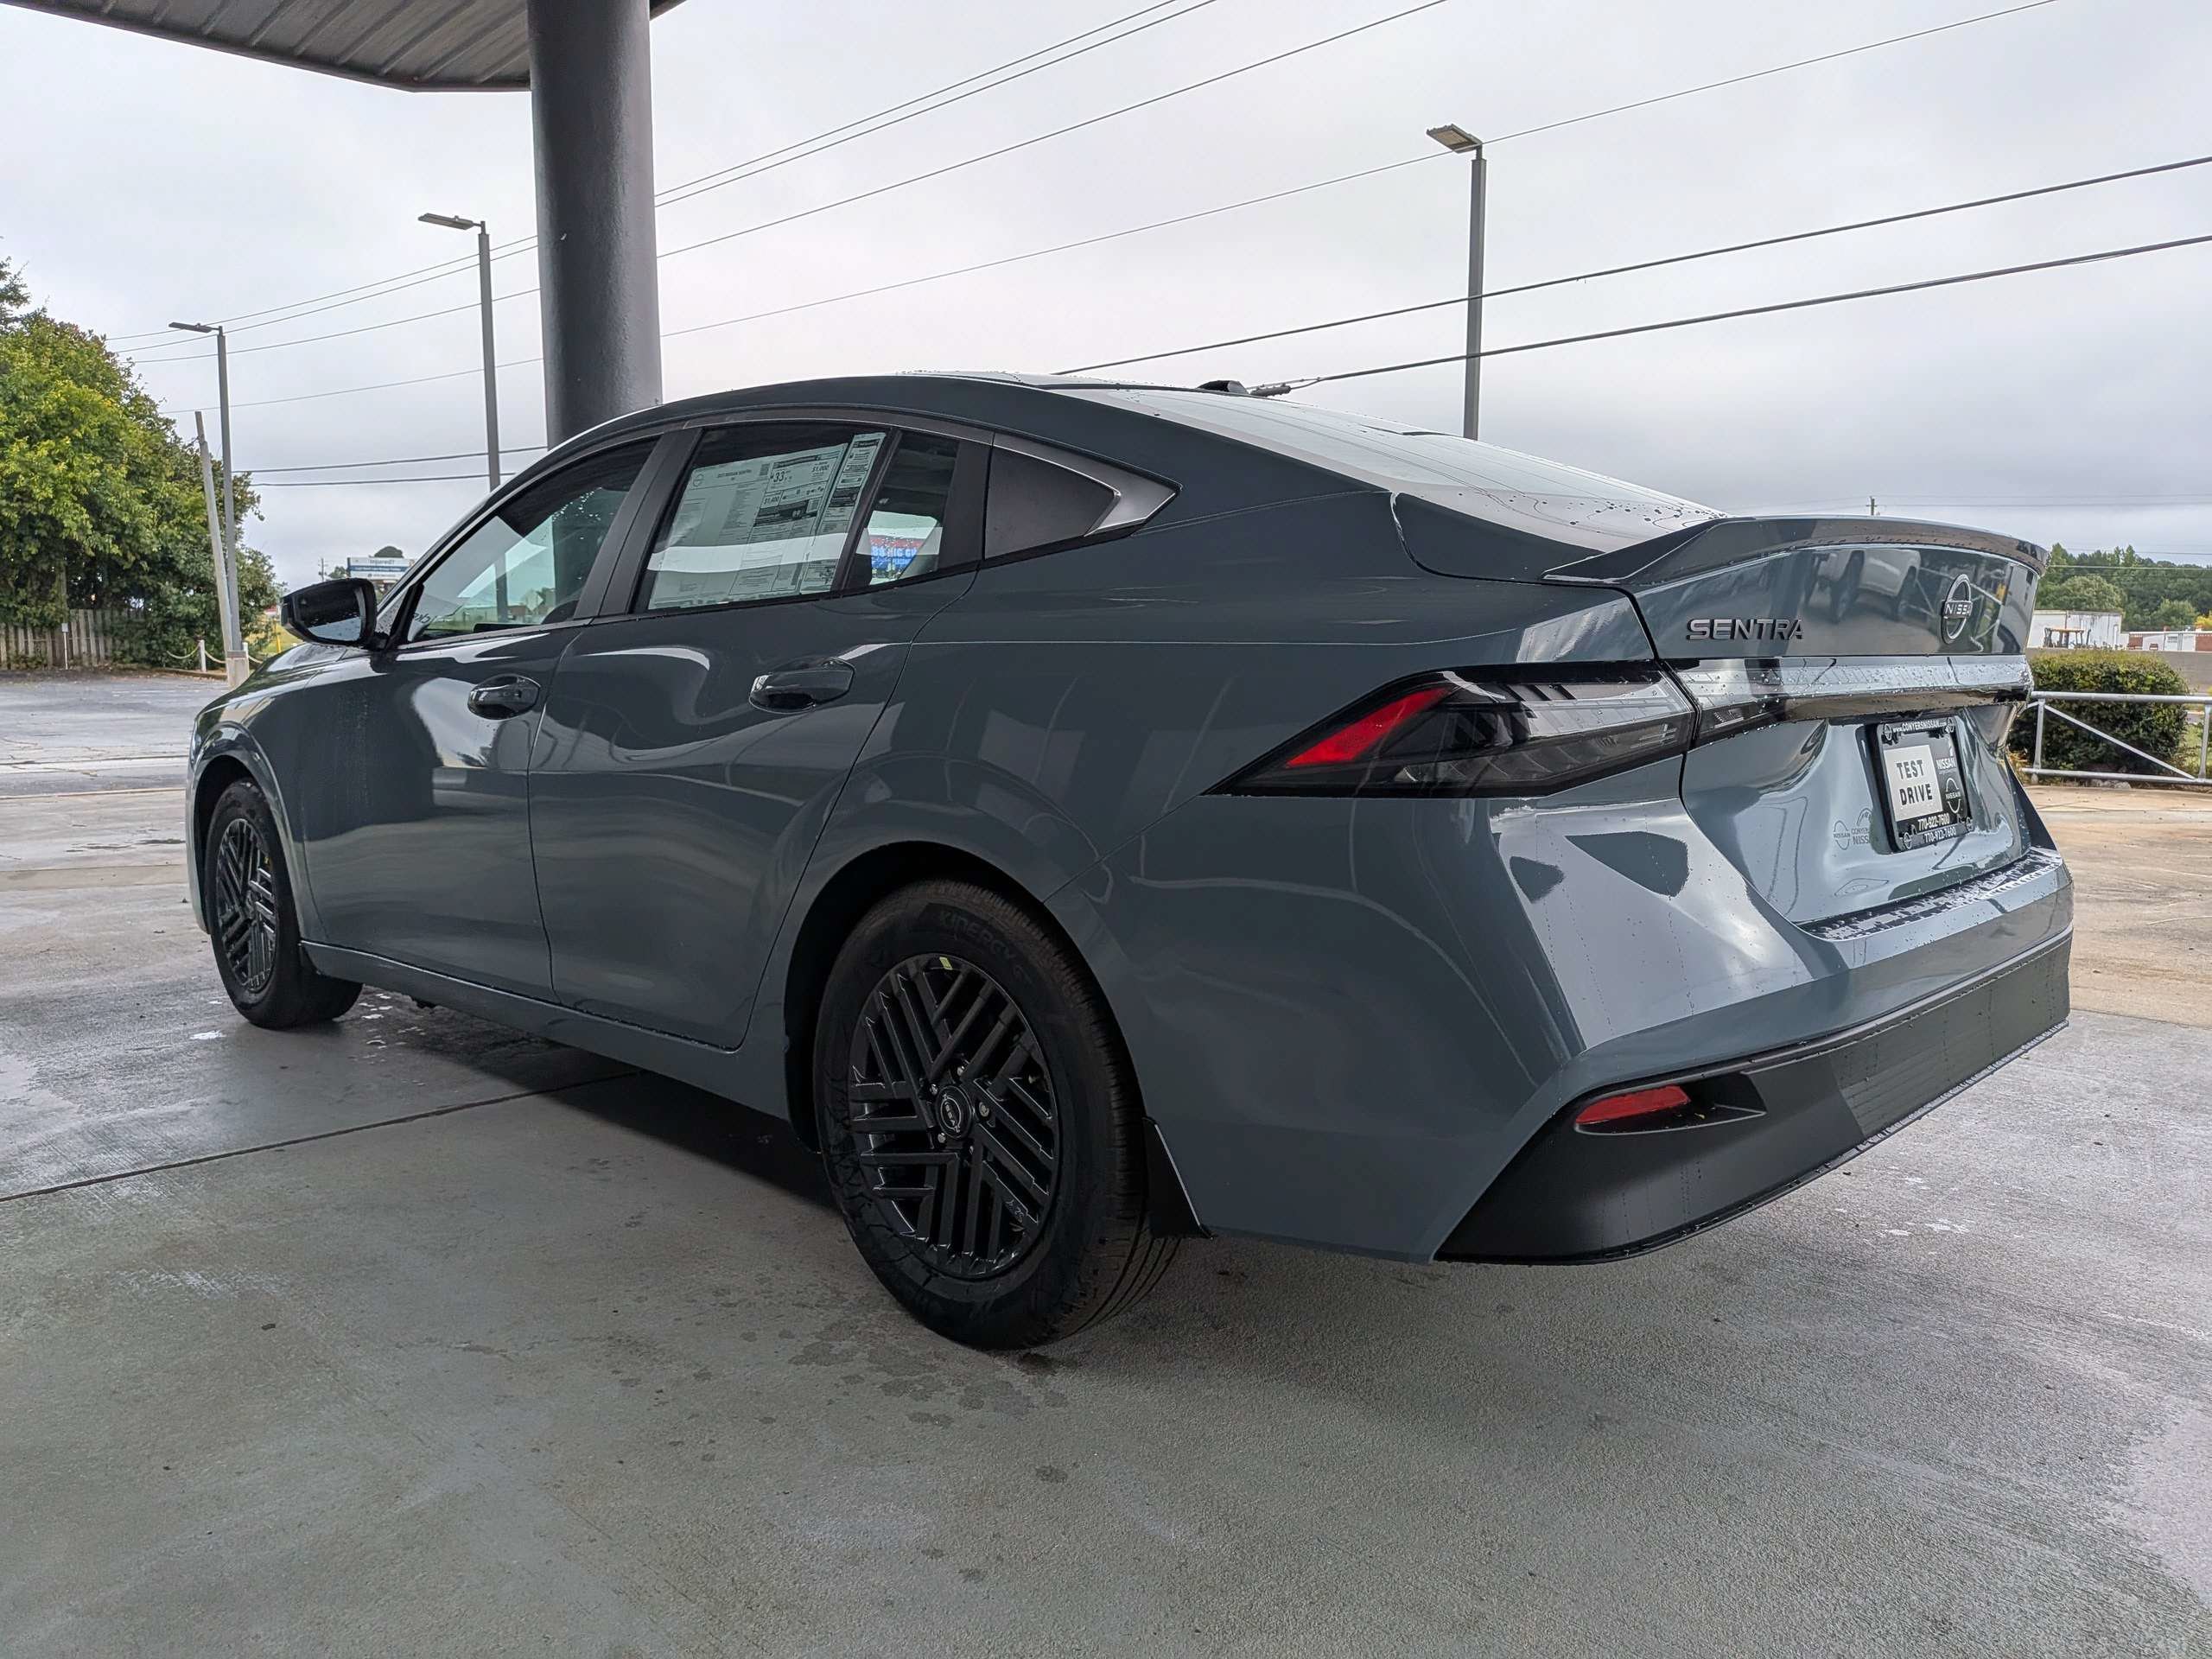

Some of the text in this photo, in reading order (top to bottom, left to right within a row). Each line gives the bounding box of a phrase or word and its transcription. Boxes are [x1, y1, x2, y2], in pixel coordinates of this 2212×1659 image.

[1687, 619, 1804, 640] SENTRA
[1896, 760, 1924, 779] TEST
[1899, 784, 1933, 805] DRIVE
